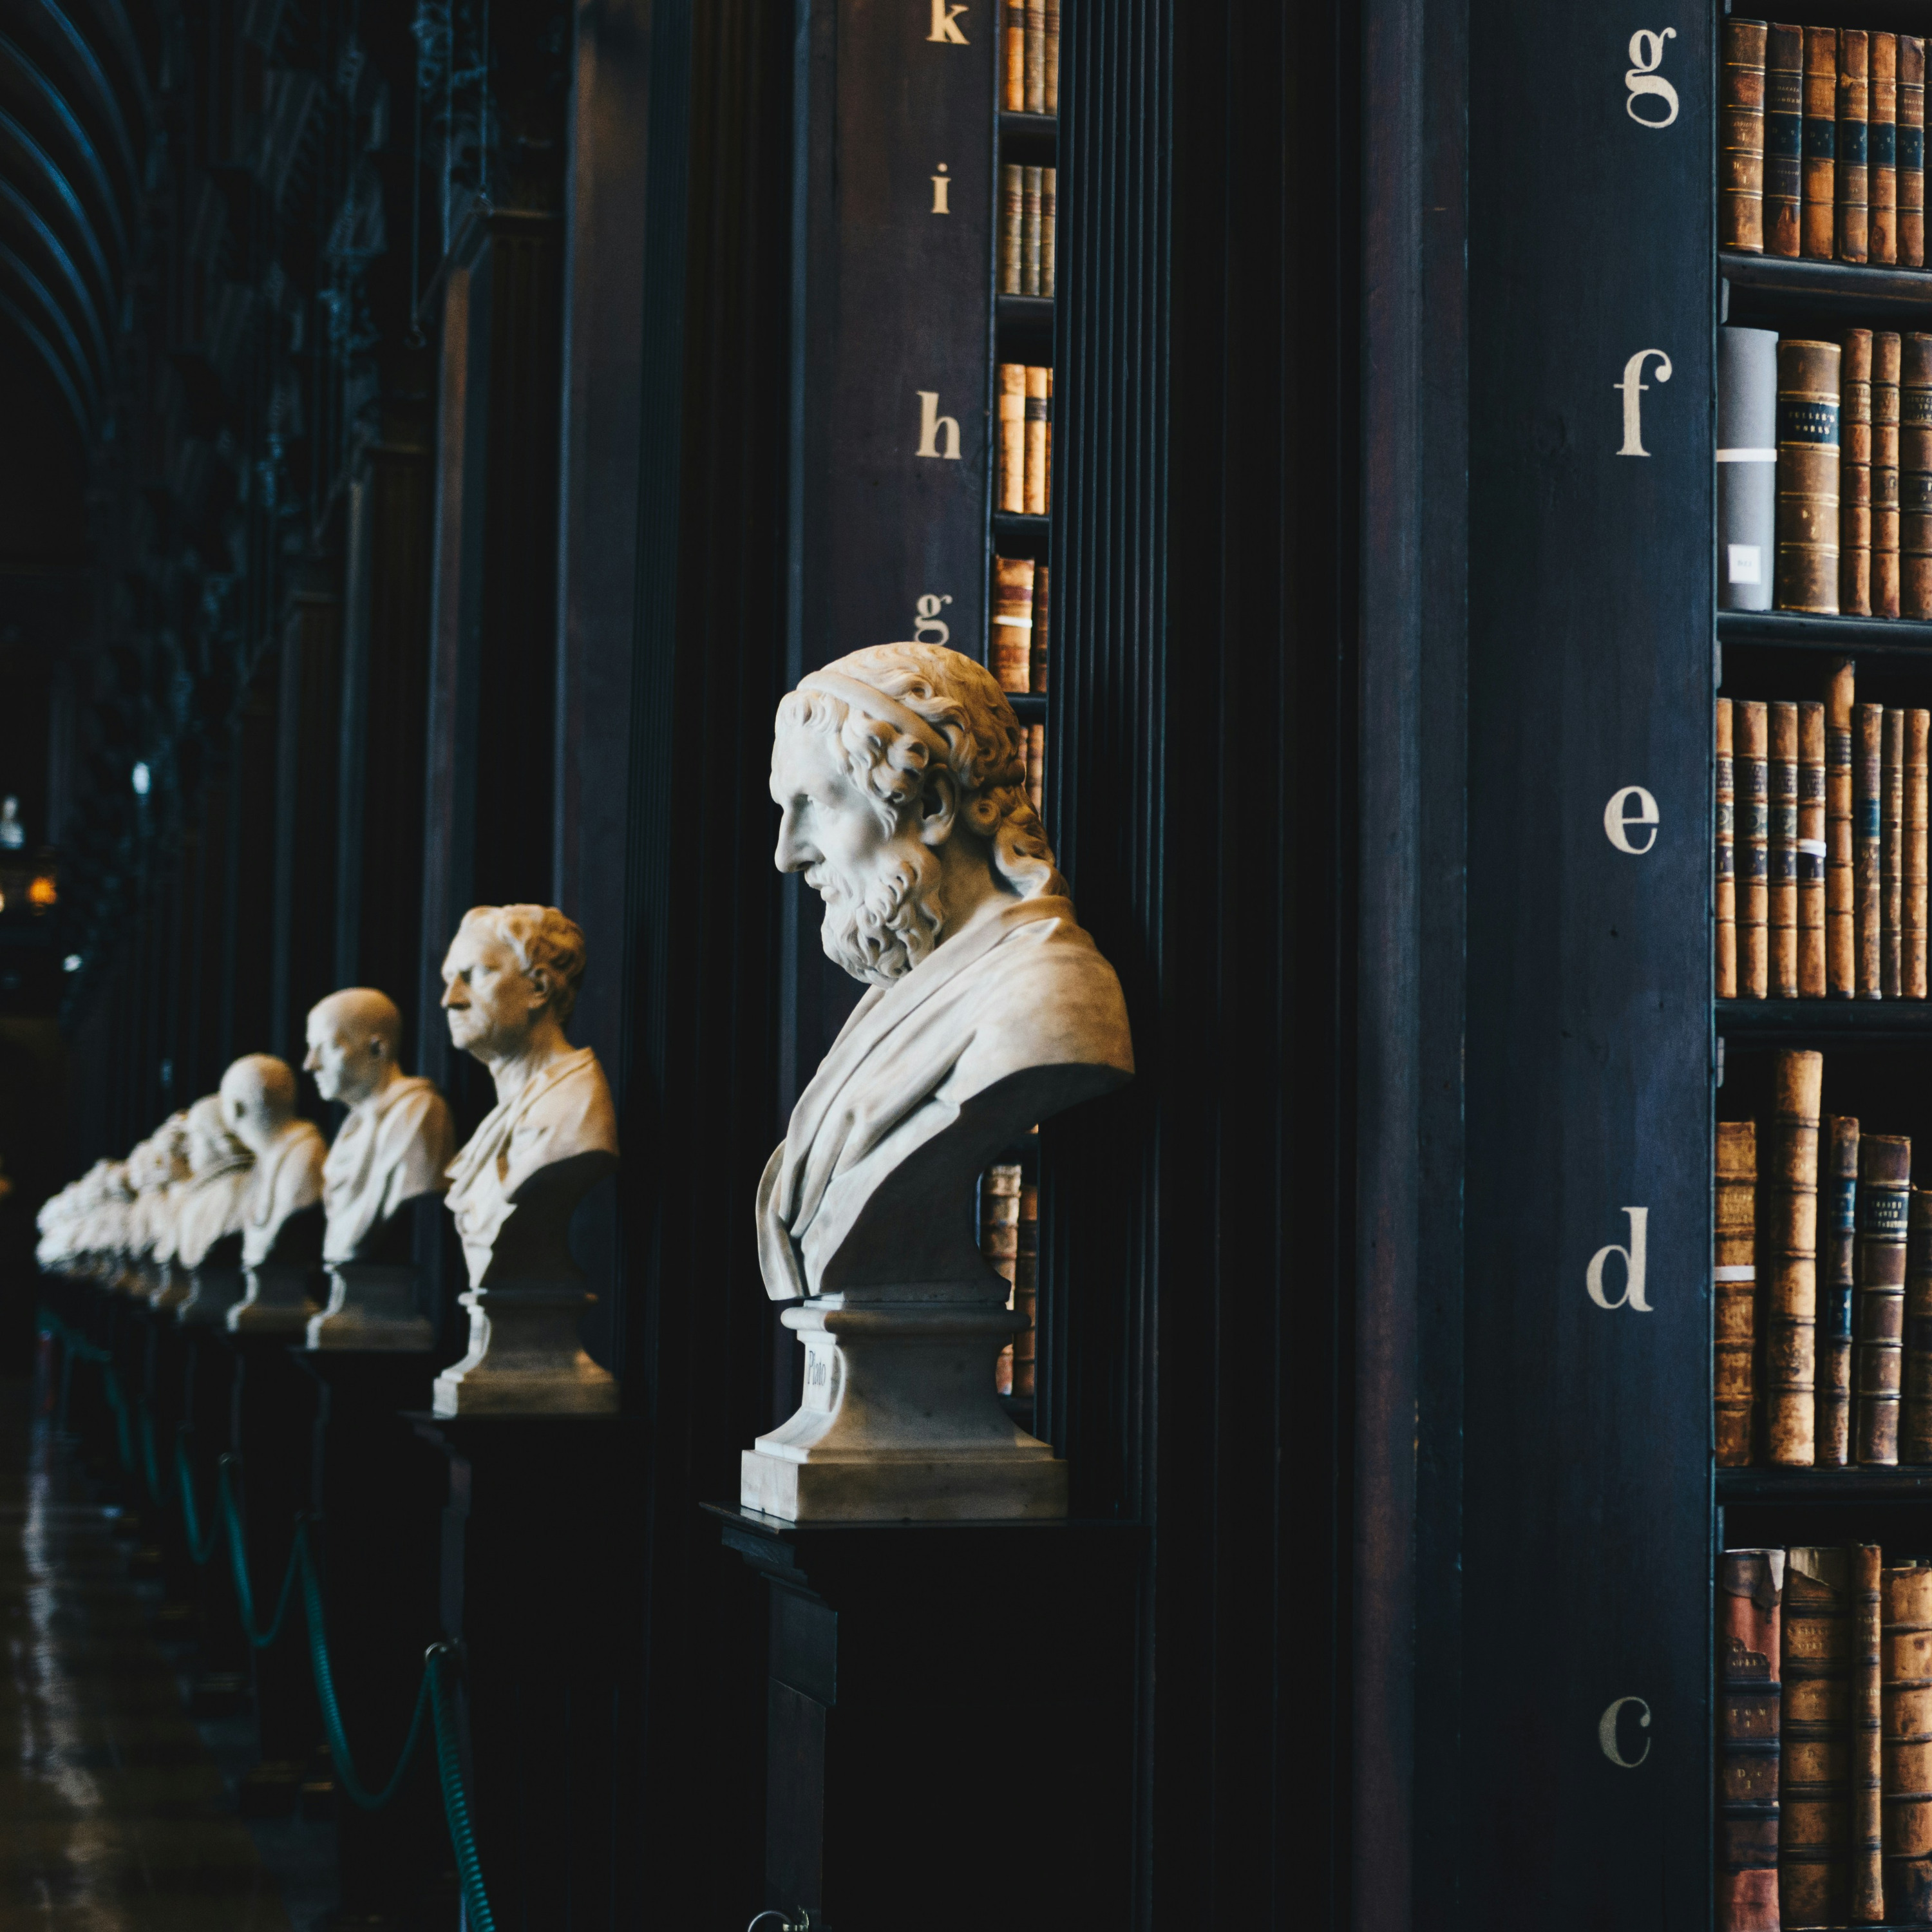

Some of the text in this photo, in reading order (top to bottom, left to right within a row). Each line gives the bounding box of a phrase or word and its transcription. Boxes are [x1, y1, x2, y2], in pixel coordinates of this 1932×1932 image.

[926, 0, 970, 44] k
[1624, 27, 1680, 129] g
[931, 162, 952, 214] i
[915, 390, 962, 460] h
[1613, 348, 1672, 457] f
[914, 594, 953, 645] g
[1603, 785, 1660, 855] e
[1586, 1206, 1653, 1312] d
[808, 1350, 826, 1387] Plato
[1598, 1695, 1651, 1770] c
